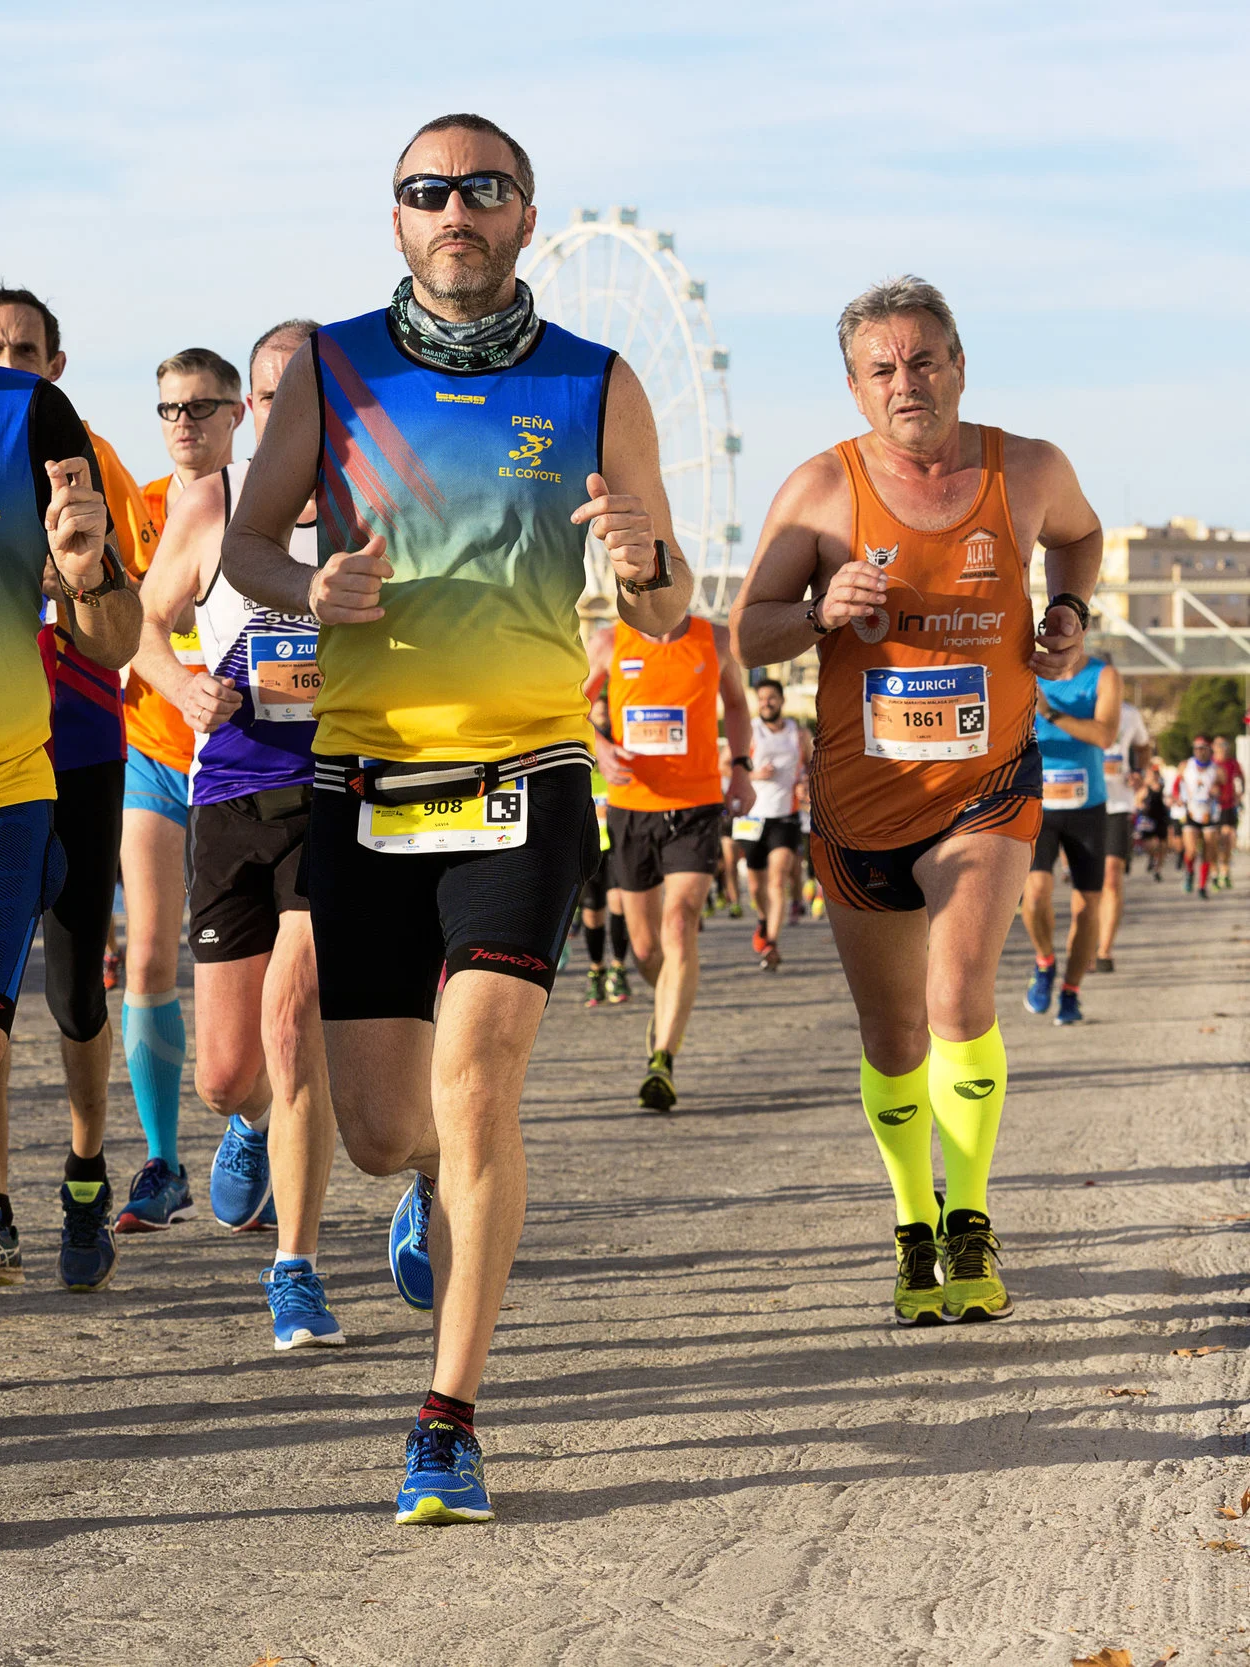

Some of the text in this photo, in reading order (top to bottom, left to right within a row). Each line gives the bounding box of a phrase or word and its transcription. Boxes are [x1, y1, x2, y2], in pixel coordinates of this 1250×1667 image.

[512, 415, 554, 431] PEÑA
[498, 467, 561, 483] EL COYOTE
[898, 607, 1005, 632] inmíner
[297, 644, 317, 655] ZU
[292, 673, 324, 689] 166
[907, 679, 956, 691] ZURICH
[903, 711, 943, 727] 1861
[424, 799, 463, 817] 908
